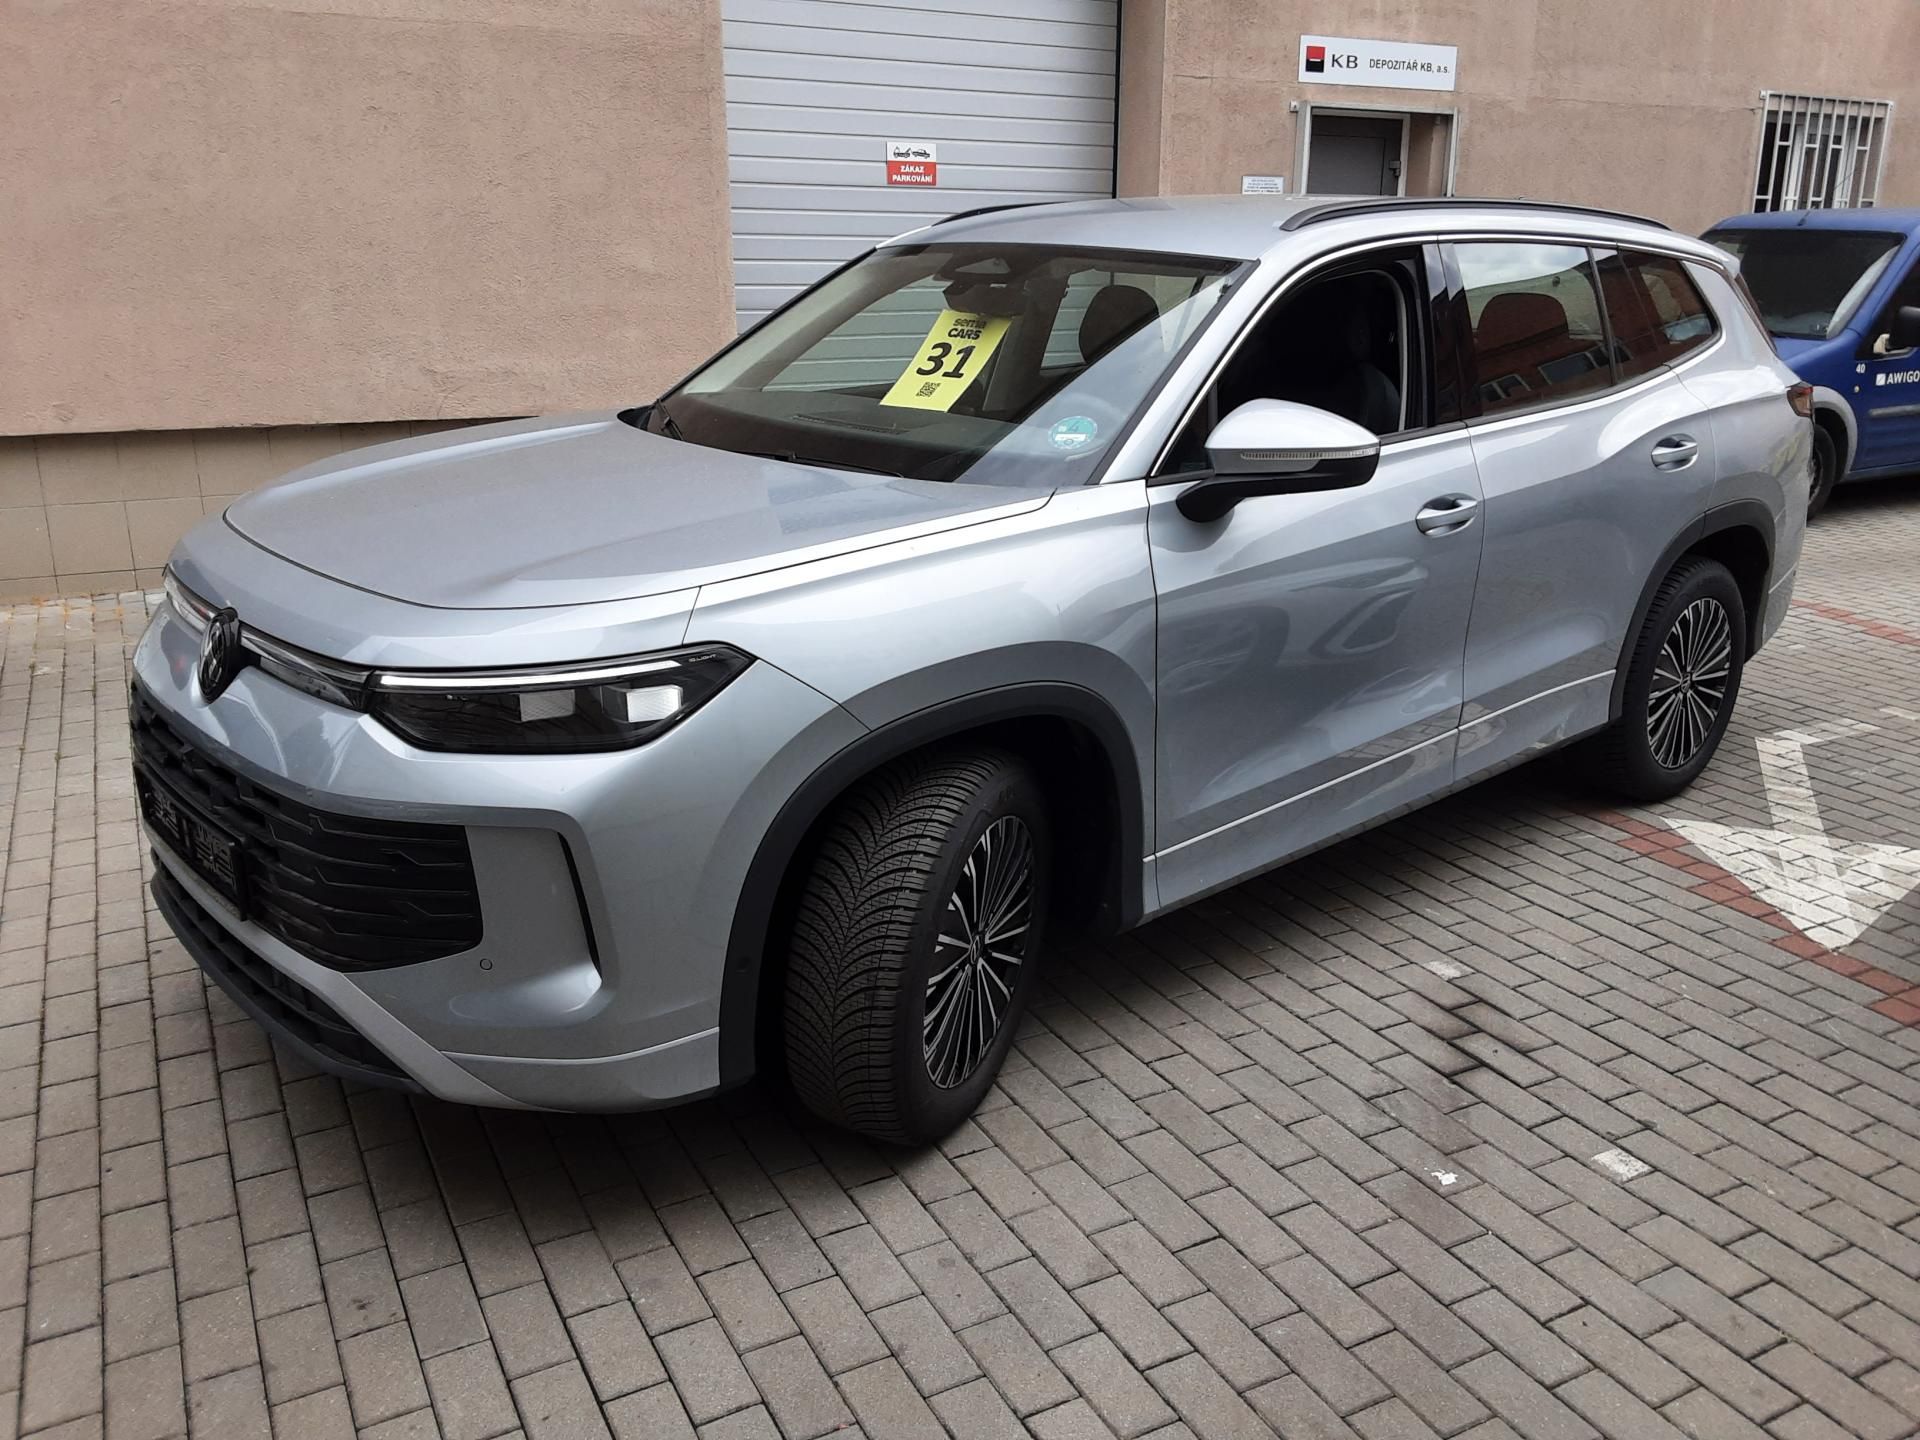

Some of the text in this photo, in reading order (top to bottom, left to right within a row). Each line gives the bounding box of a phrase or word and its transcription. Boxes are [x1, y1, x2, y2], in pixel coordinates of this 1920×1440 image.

[1331, 53, 1450, 73] KB DEPOZITÁŘ KB, a.s.
[900, 164, 925, 173] ZÁKAZ
[892, 174, 933, 183] PARKOVÁNÍ
[947, 328, 982, 340] CARS
[916, 342, 976, 378] 31
[1856, 363, 1866, 373] 40
[1886, 370, 1920, 385] AWIGO
